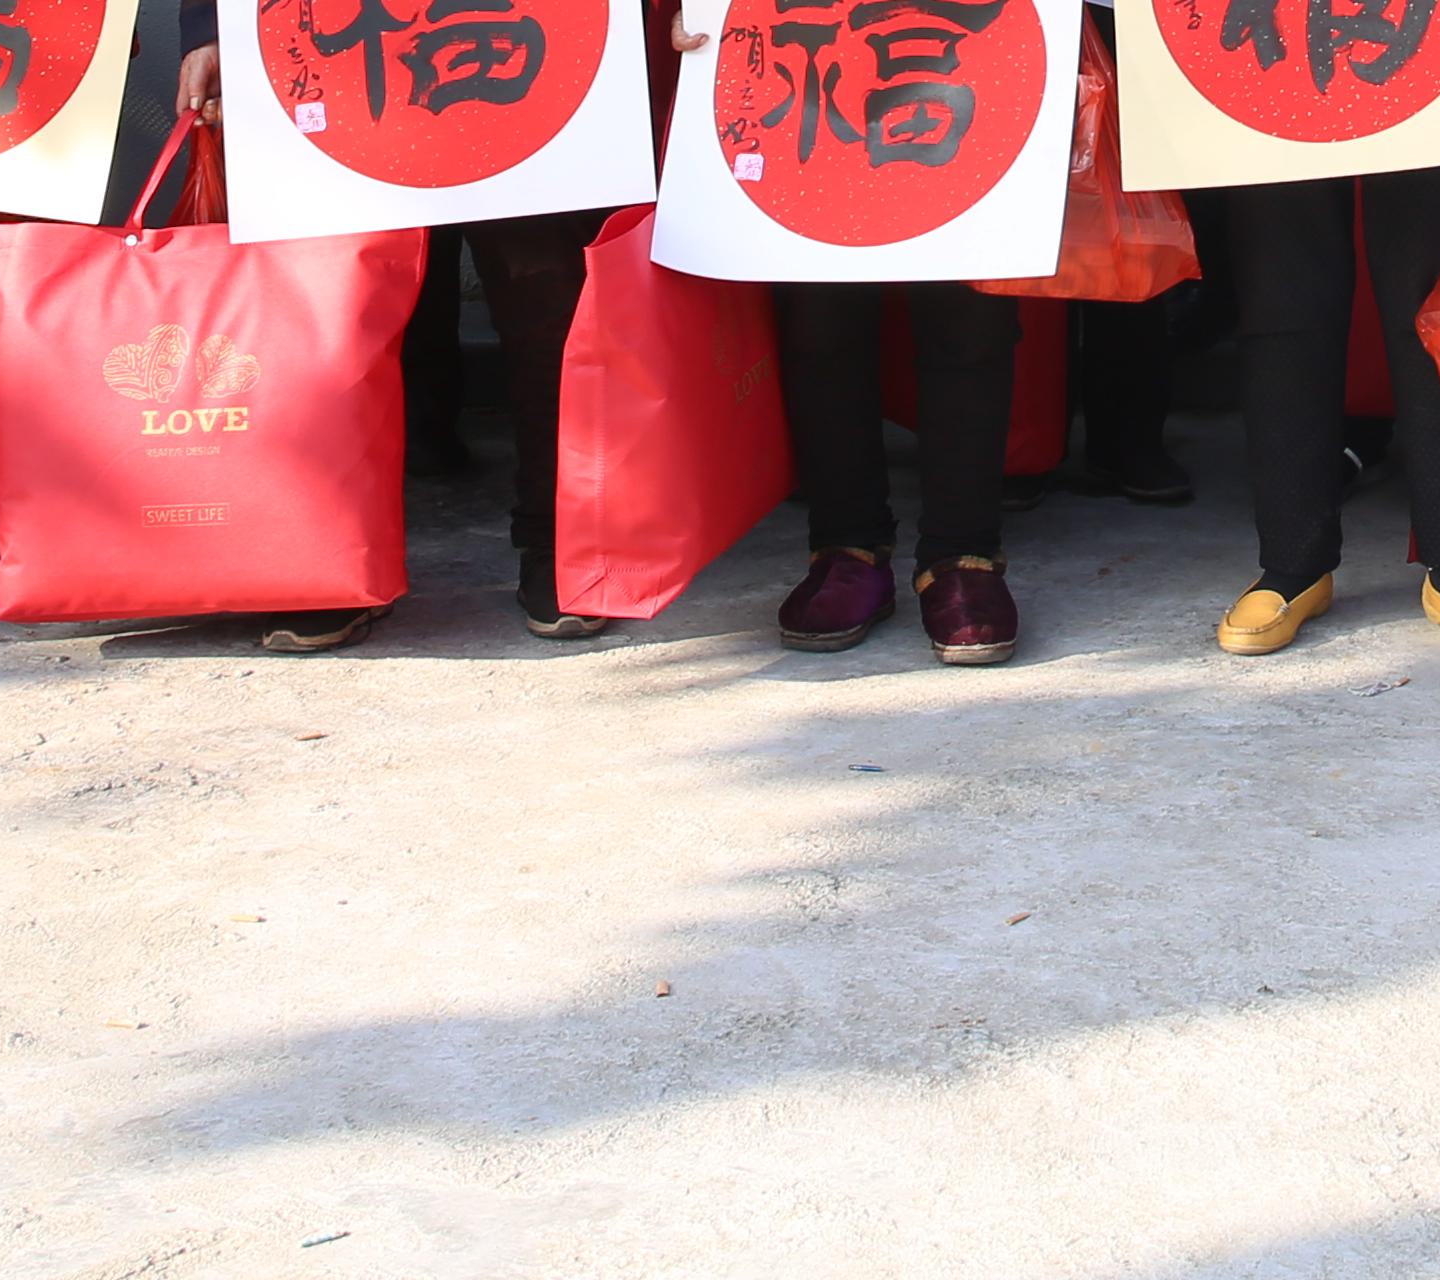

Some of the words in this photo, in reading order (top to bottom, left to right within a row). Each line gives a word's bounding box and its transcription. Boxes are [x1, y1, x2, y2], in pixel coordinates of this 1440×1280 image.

[141, 407, 249, 435] LOVE
[146, 509, 193, 524] SWEET
[197, 507, 225, 521] LIFE
